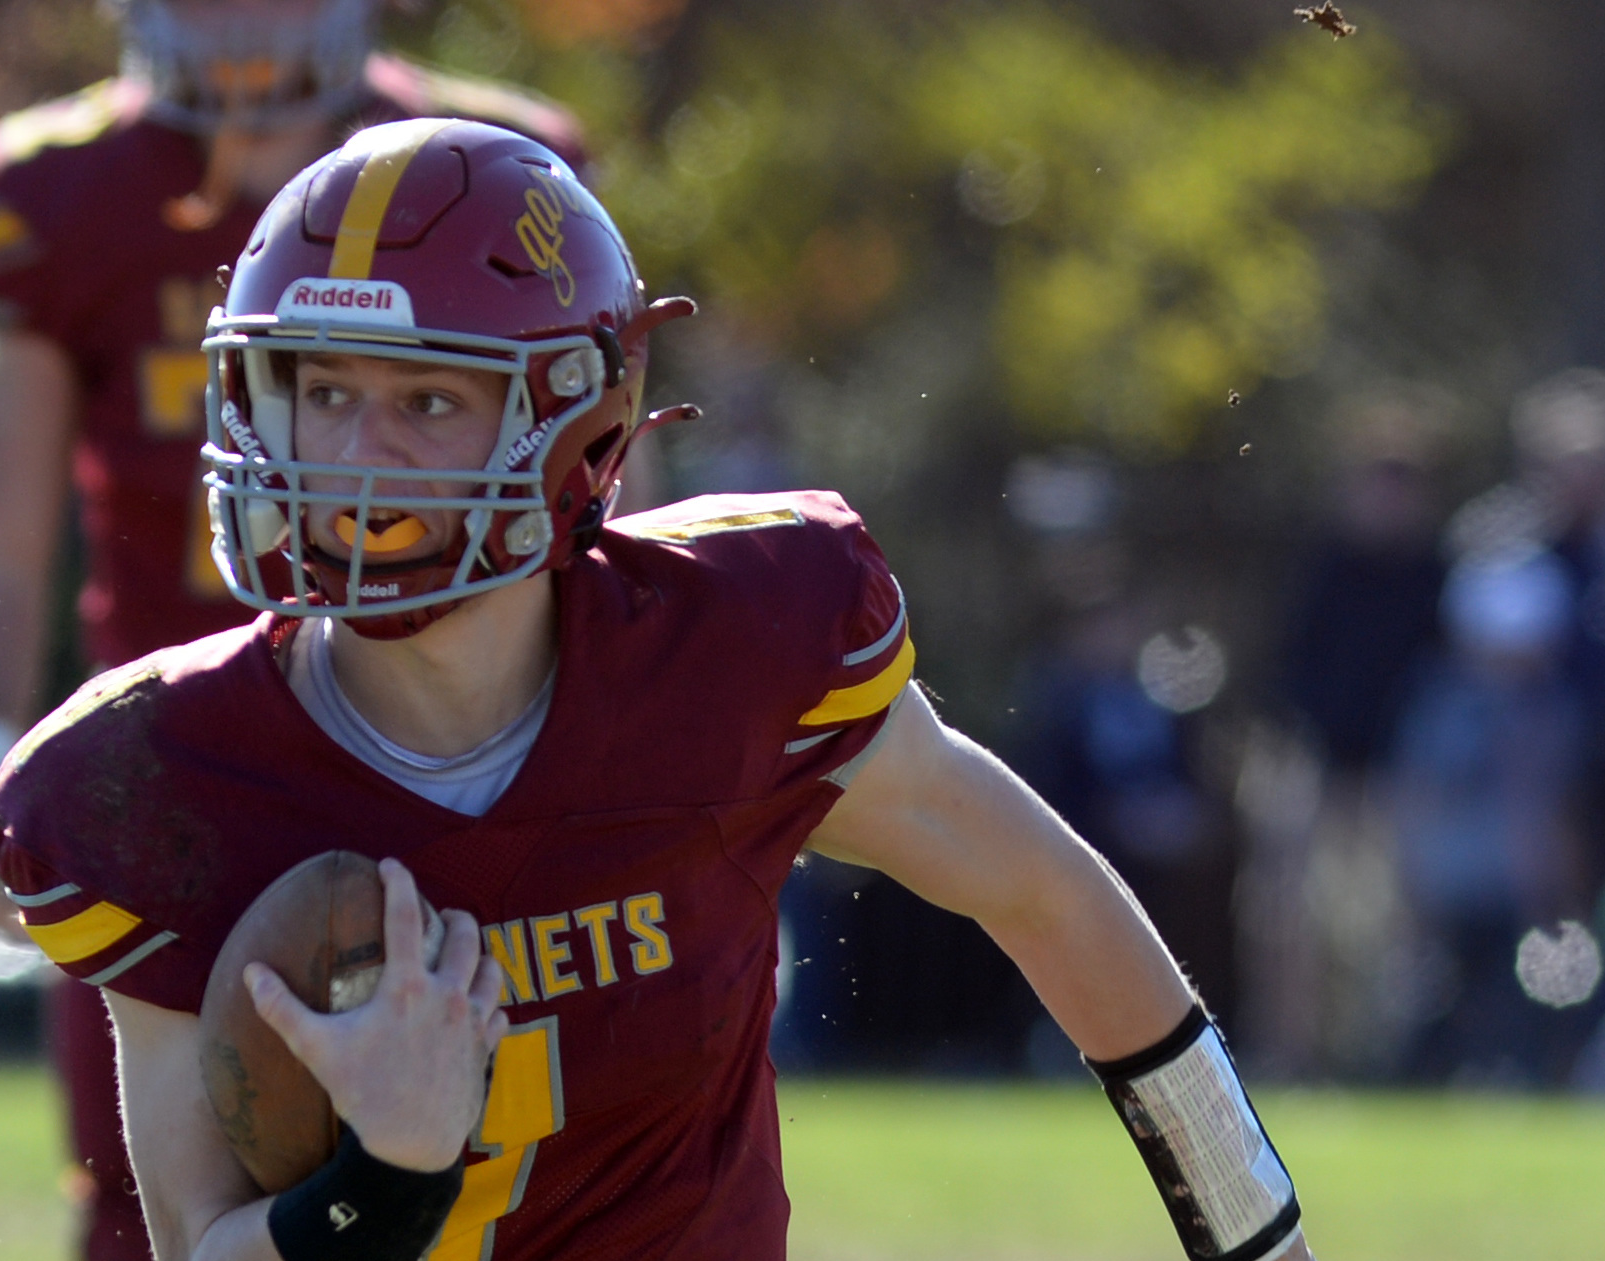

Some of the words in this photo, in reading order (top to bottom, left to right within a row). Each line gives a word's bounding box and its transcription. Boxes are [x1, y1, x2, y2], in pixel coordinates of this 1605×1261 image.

[293, 285, 393, 310] Riddell
[221, 400, 274, 485] Riddel
[504, 417, 554, 471] ddel
[346, 583, 399, 598] ddell
[480, 891, 673, 1006] NETS
